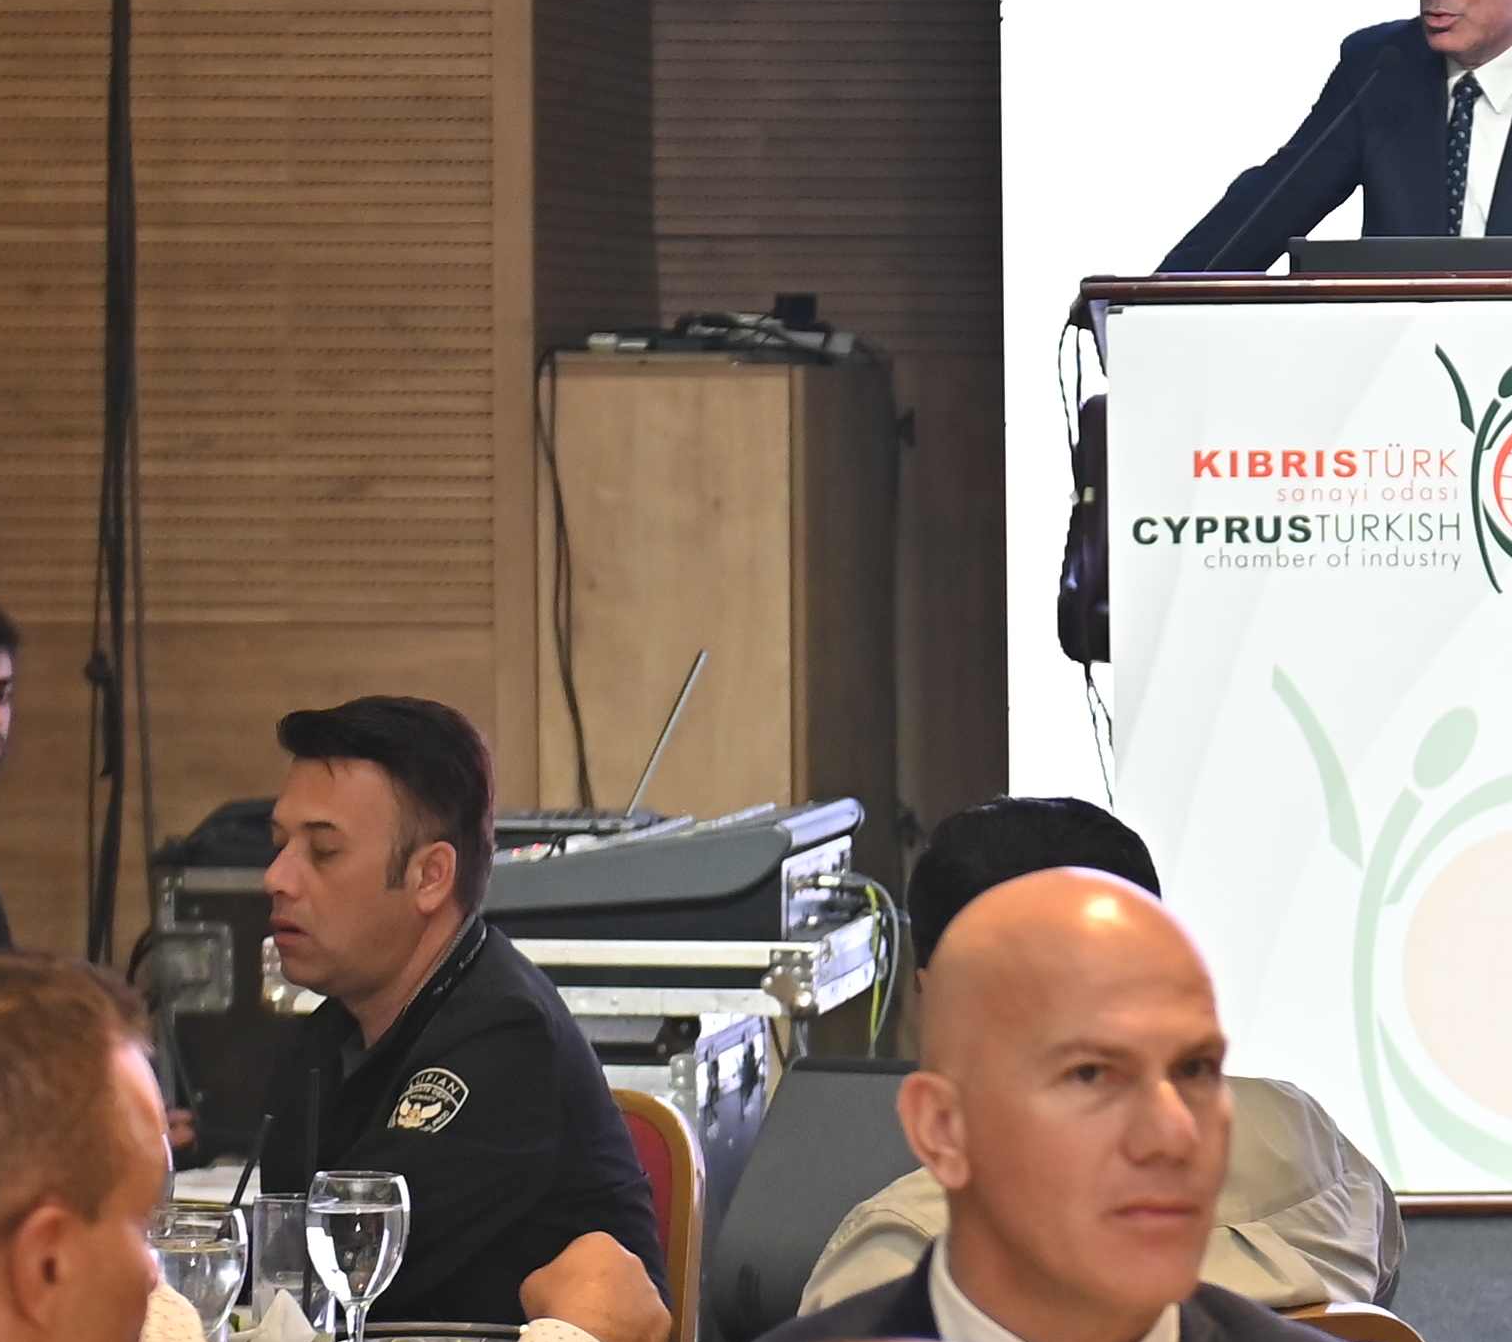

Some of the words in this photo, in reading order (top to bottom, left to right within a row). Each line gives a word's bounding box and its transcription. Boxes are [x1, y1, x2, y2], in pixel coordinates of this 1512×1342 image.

[1276, 484, 1369, 506] sanayi
[1380, 480, 1459, 502] odası
[1203, 547, 1318, 569] chamber
[1326, 547, 1351, 569] of
[1361, 547, 1463, 573] industry
